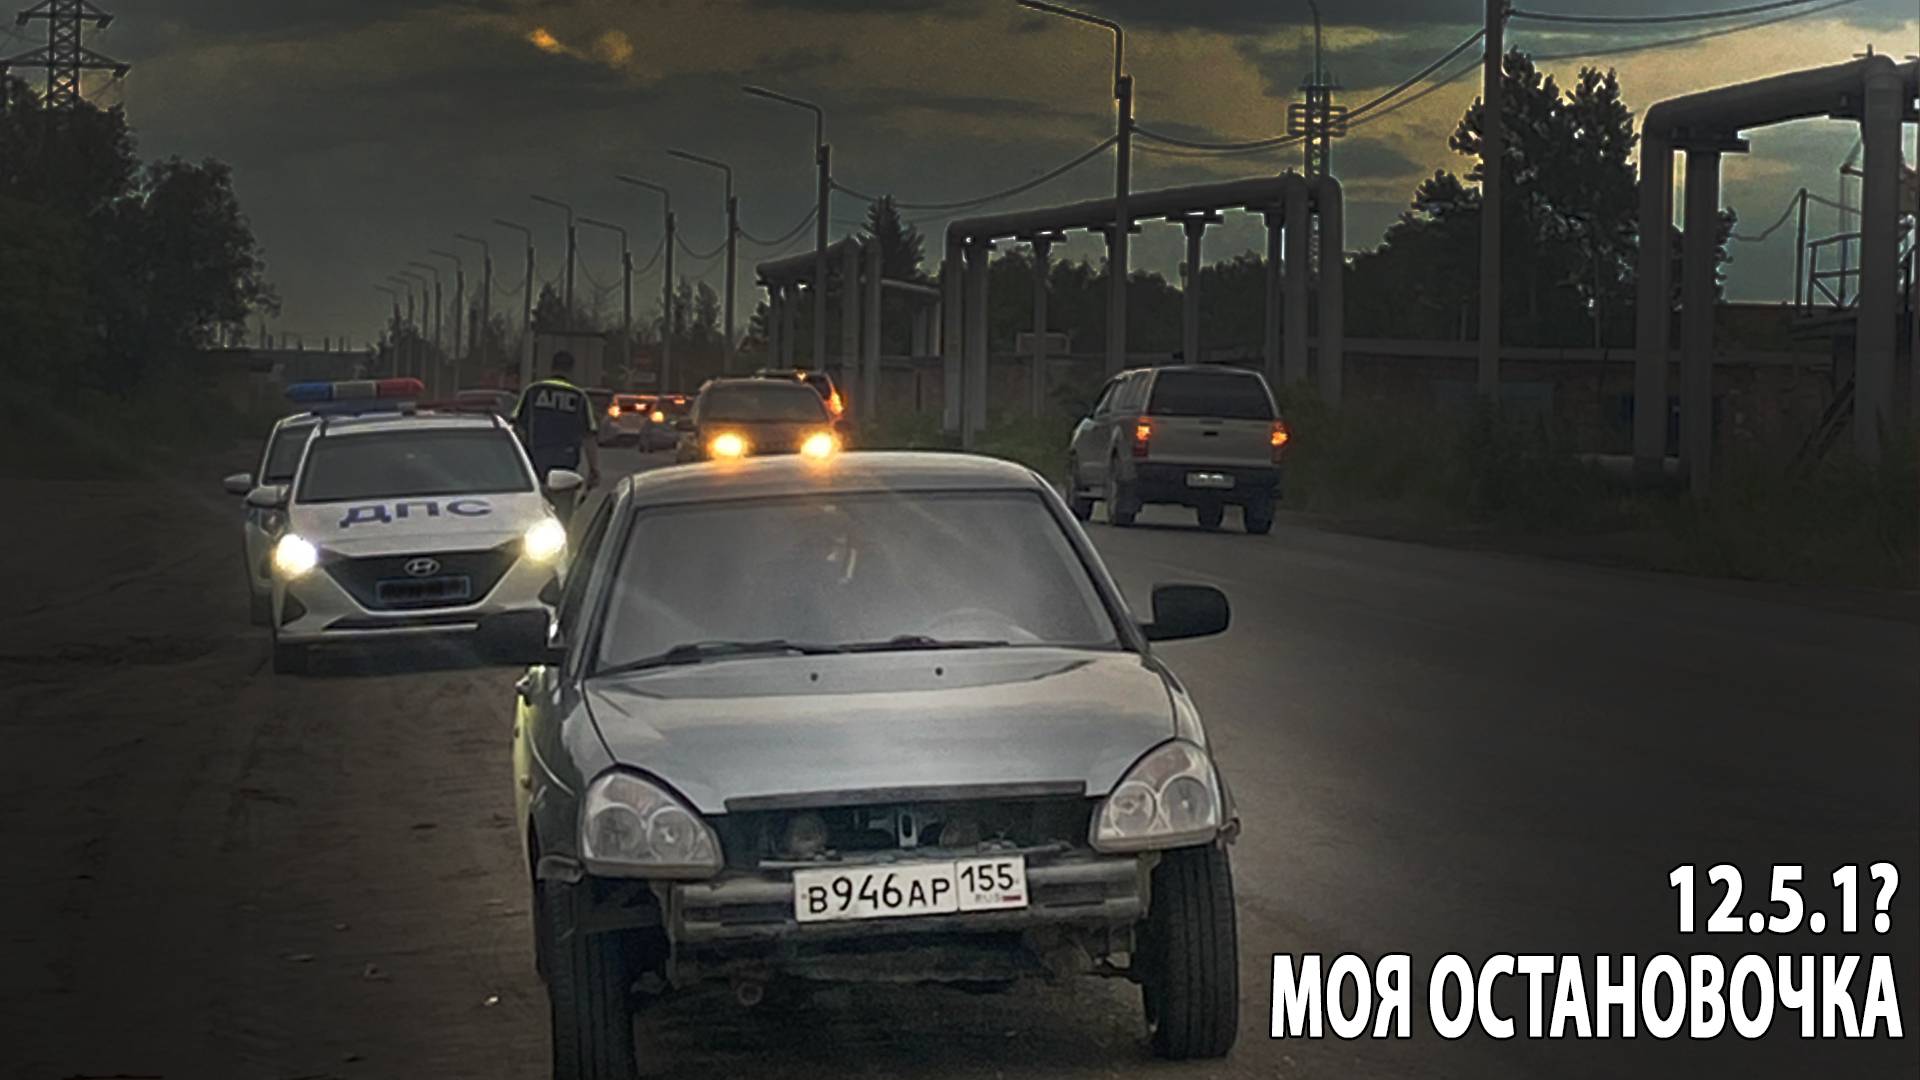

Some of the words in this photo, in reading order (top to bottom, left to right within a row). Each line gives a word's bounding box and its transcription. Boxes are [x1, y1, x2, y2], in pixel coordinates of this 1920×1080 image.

[535, 390, 577, 412] ДПС
[339, 499, 492, 528] ДПС
[808, 873, 950, 914] В946АР
[960, 863, 1014, 893] 155
